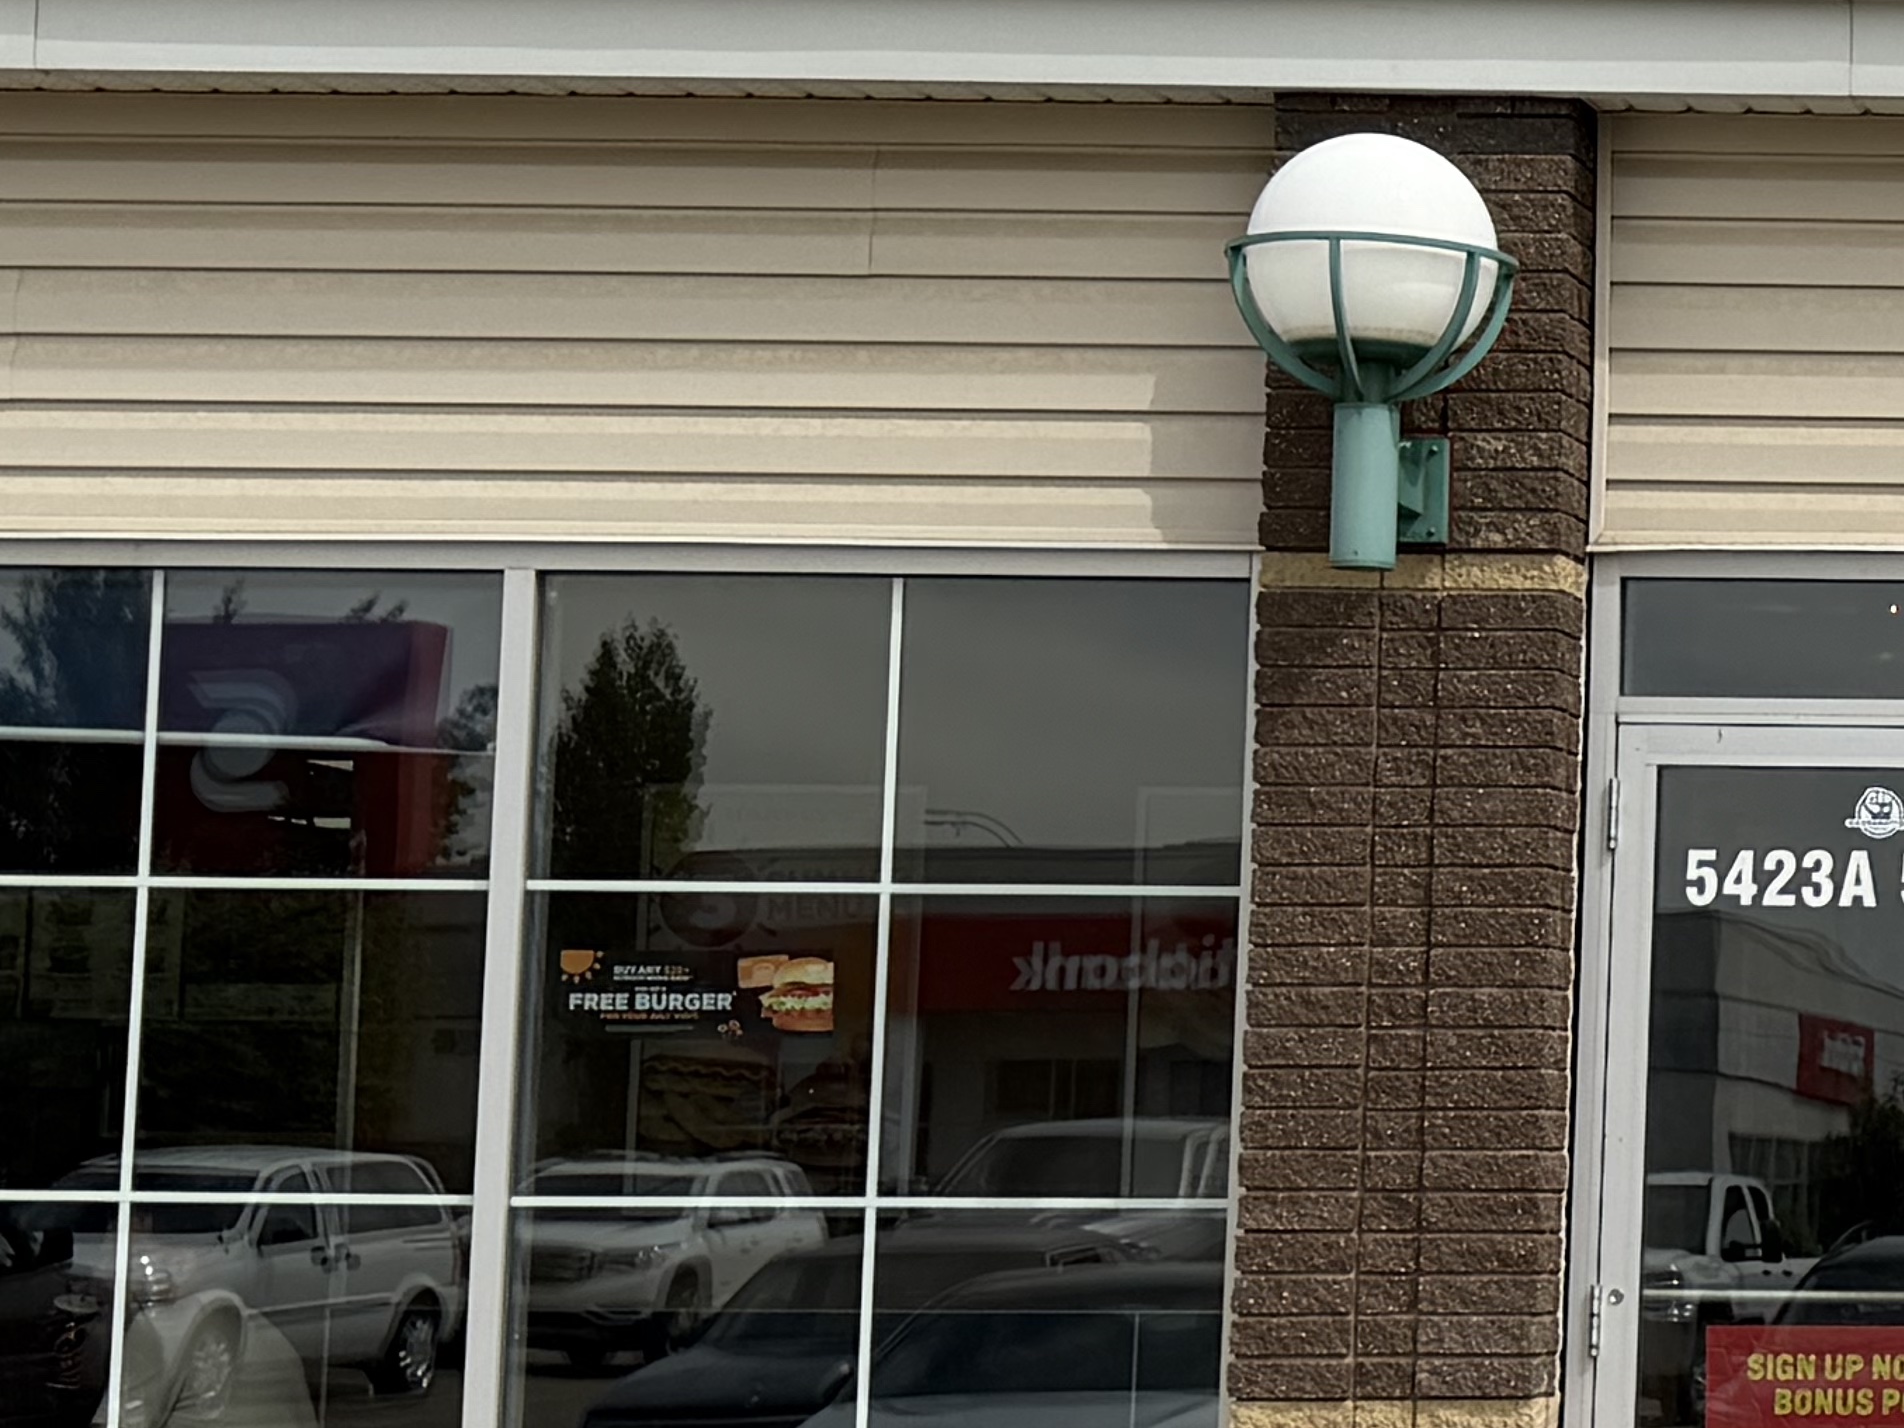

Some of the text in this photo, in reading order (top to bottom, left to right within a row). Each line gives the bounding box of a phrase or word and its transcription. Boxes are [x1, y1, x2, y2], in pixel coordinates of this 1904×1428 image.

[1685, 849, 1877, 909] 5423A
[568, 992, 733, 1011] FREE BURGER
[1747, 1354, 1817, 1381] SIGN
[1825, 1354, 1864, 1381] UP
[1774, 1388, 1875, 1417] BONUS
